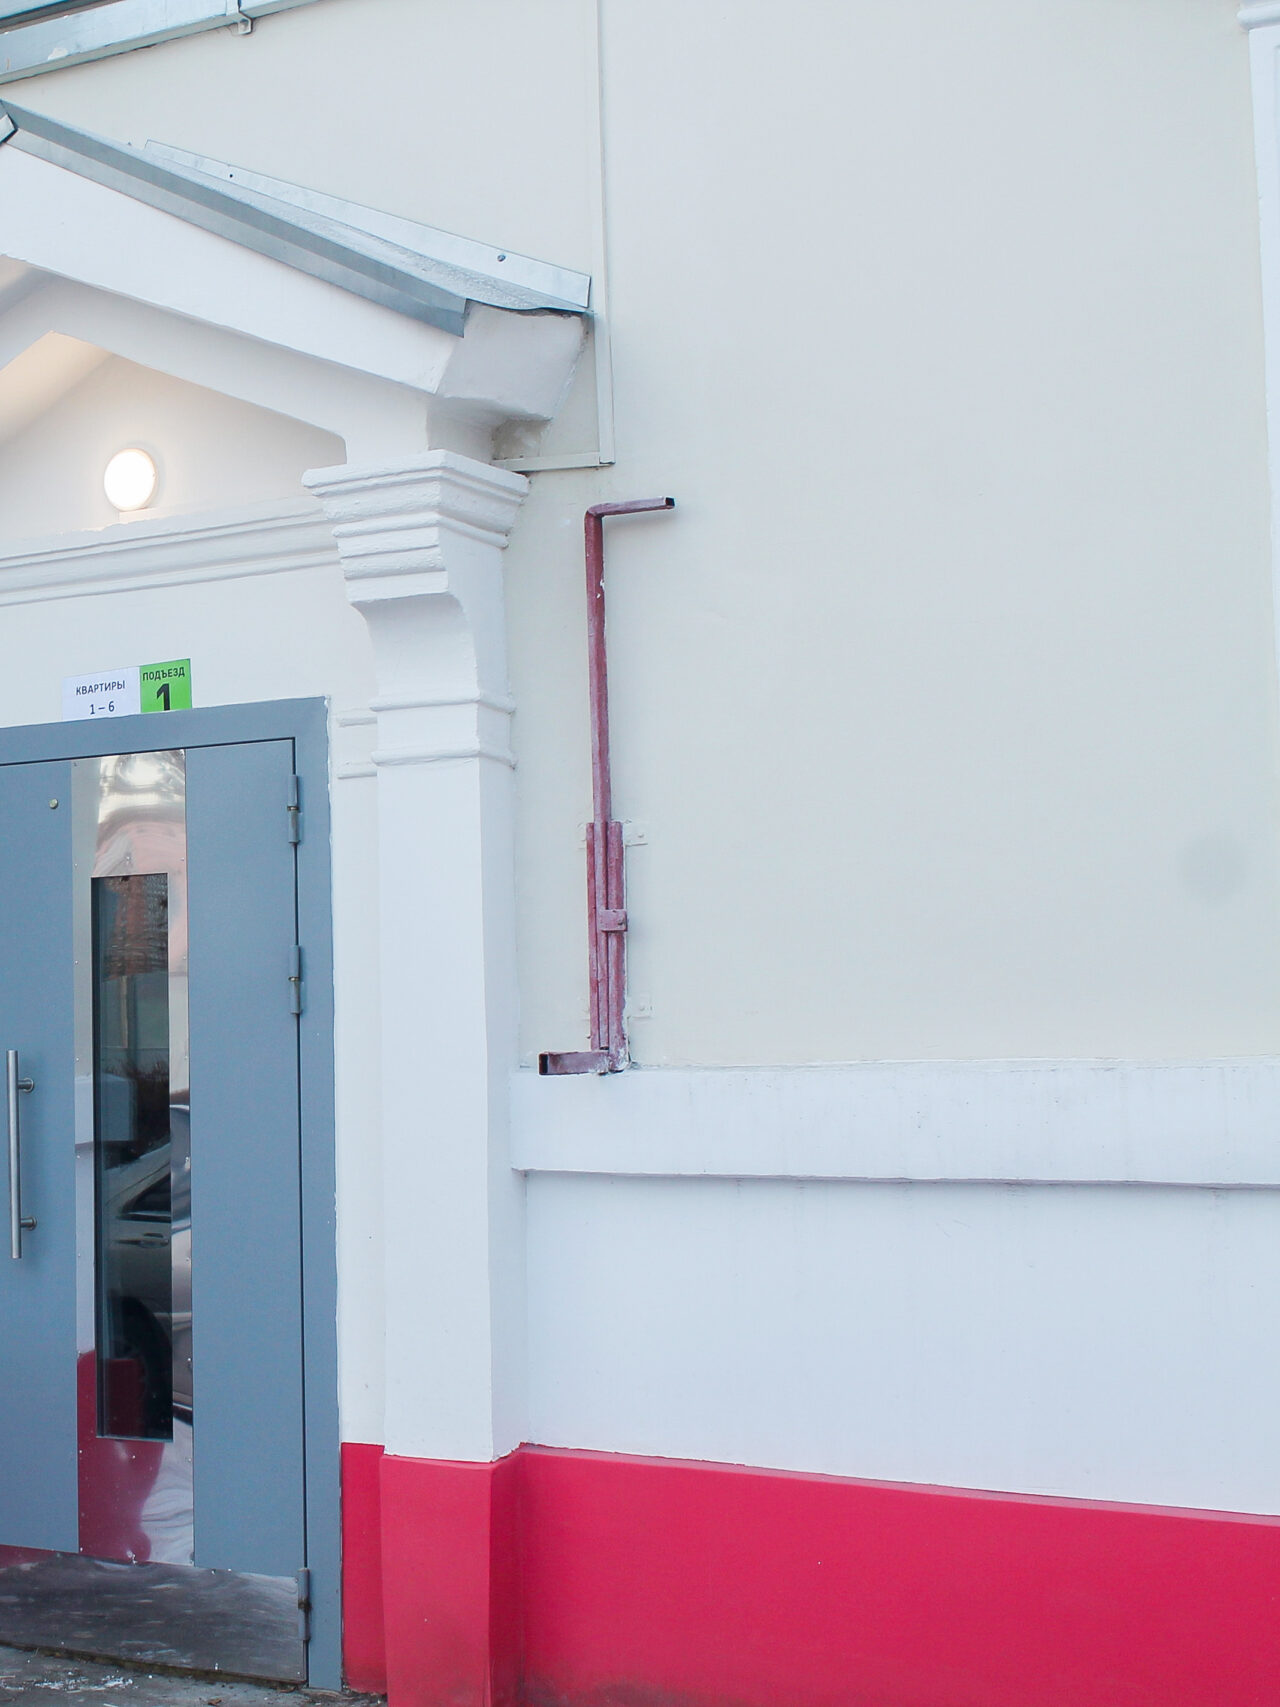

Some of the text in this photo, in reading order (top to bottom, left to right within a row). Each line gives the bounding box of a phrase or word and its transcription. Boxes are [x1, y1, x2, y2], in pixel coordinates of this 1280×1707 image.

[142, 666, 185, 681] ПОДЪЕЗД
[76, 680, 126, 695] КВАРТИРЫ
[156, 683, 171, 711] 1
